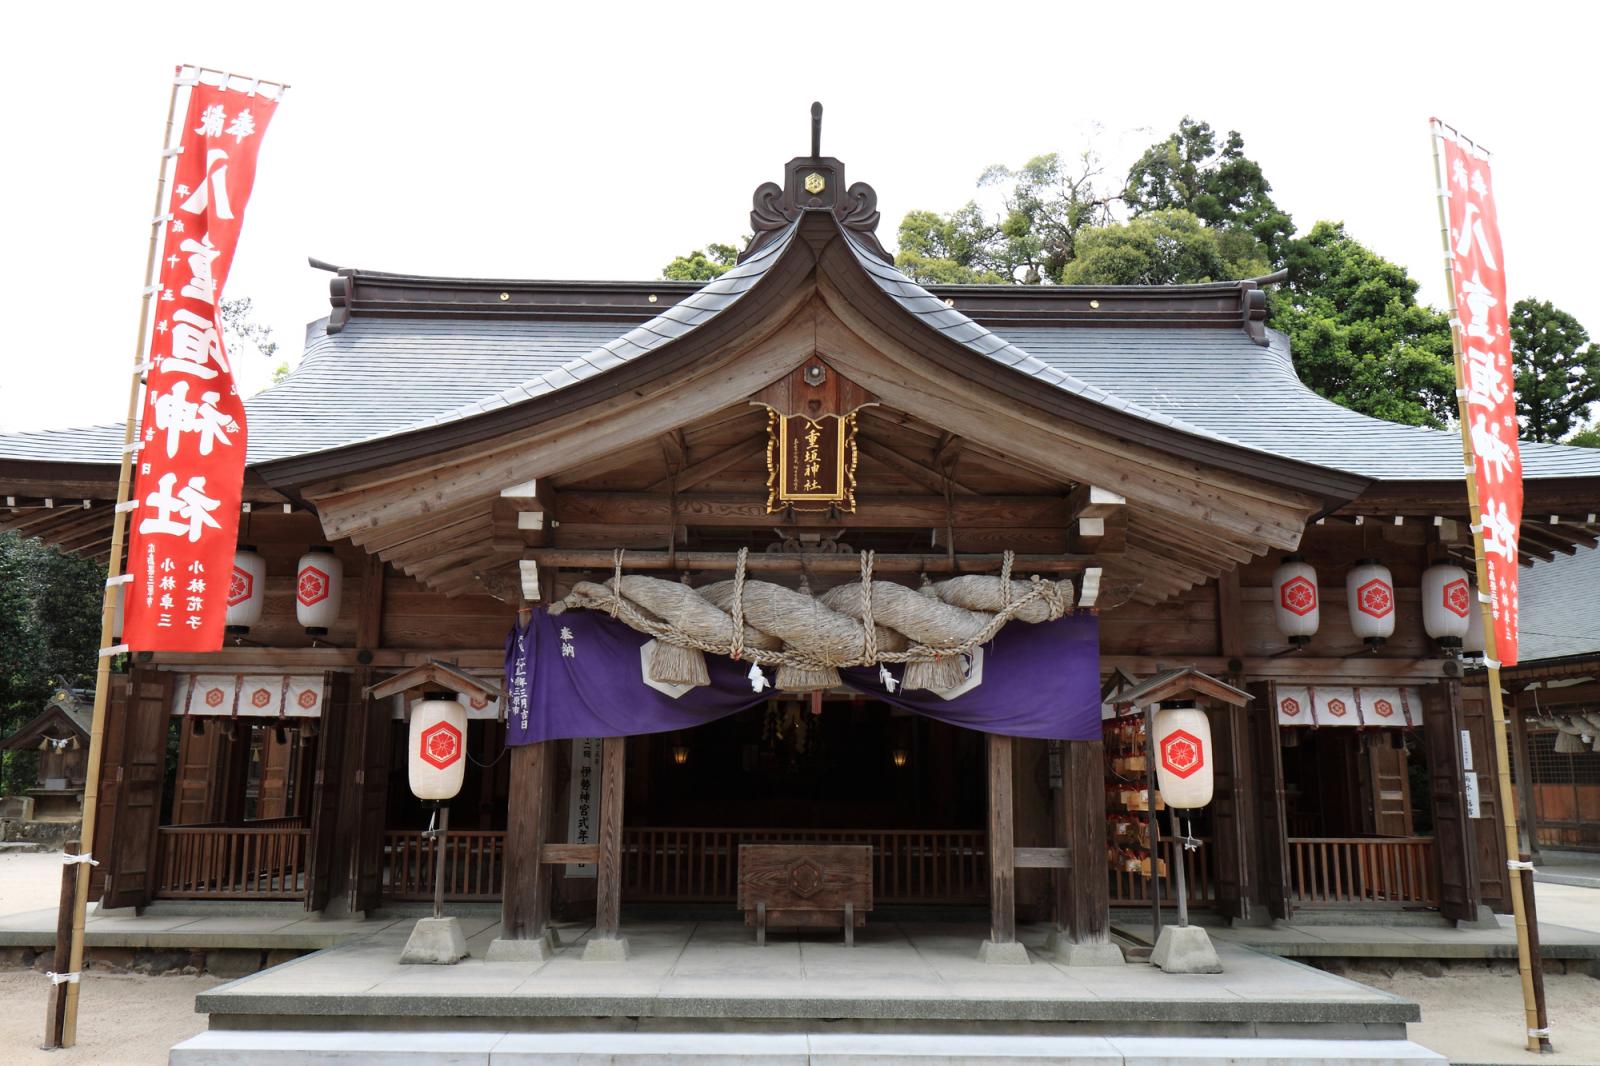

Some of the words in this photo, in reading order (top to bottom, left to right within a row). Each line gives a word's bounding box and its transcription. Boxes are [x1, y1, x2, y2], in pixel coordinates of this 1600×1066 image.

[803, 421, 824, 491] 八重垣神社
[559, 626, 575, 658] 奉納
